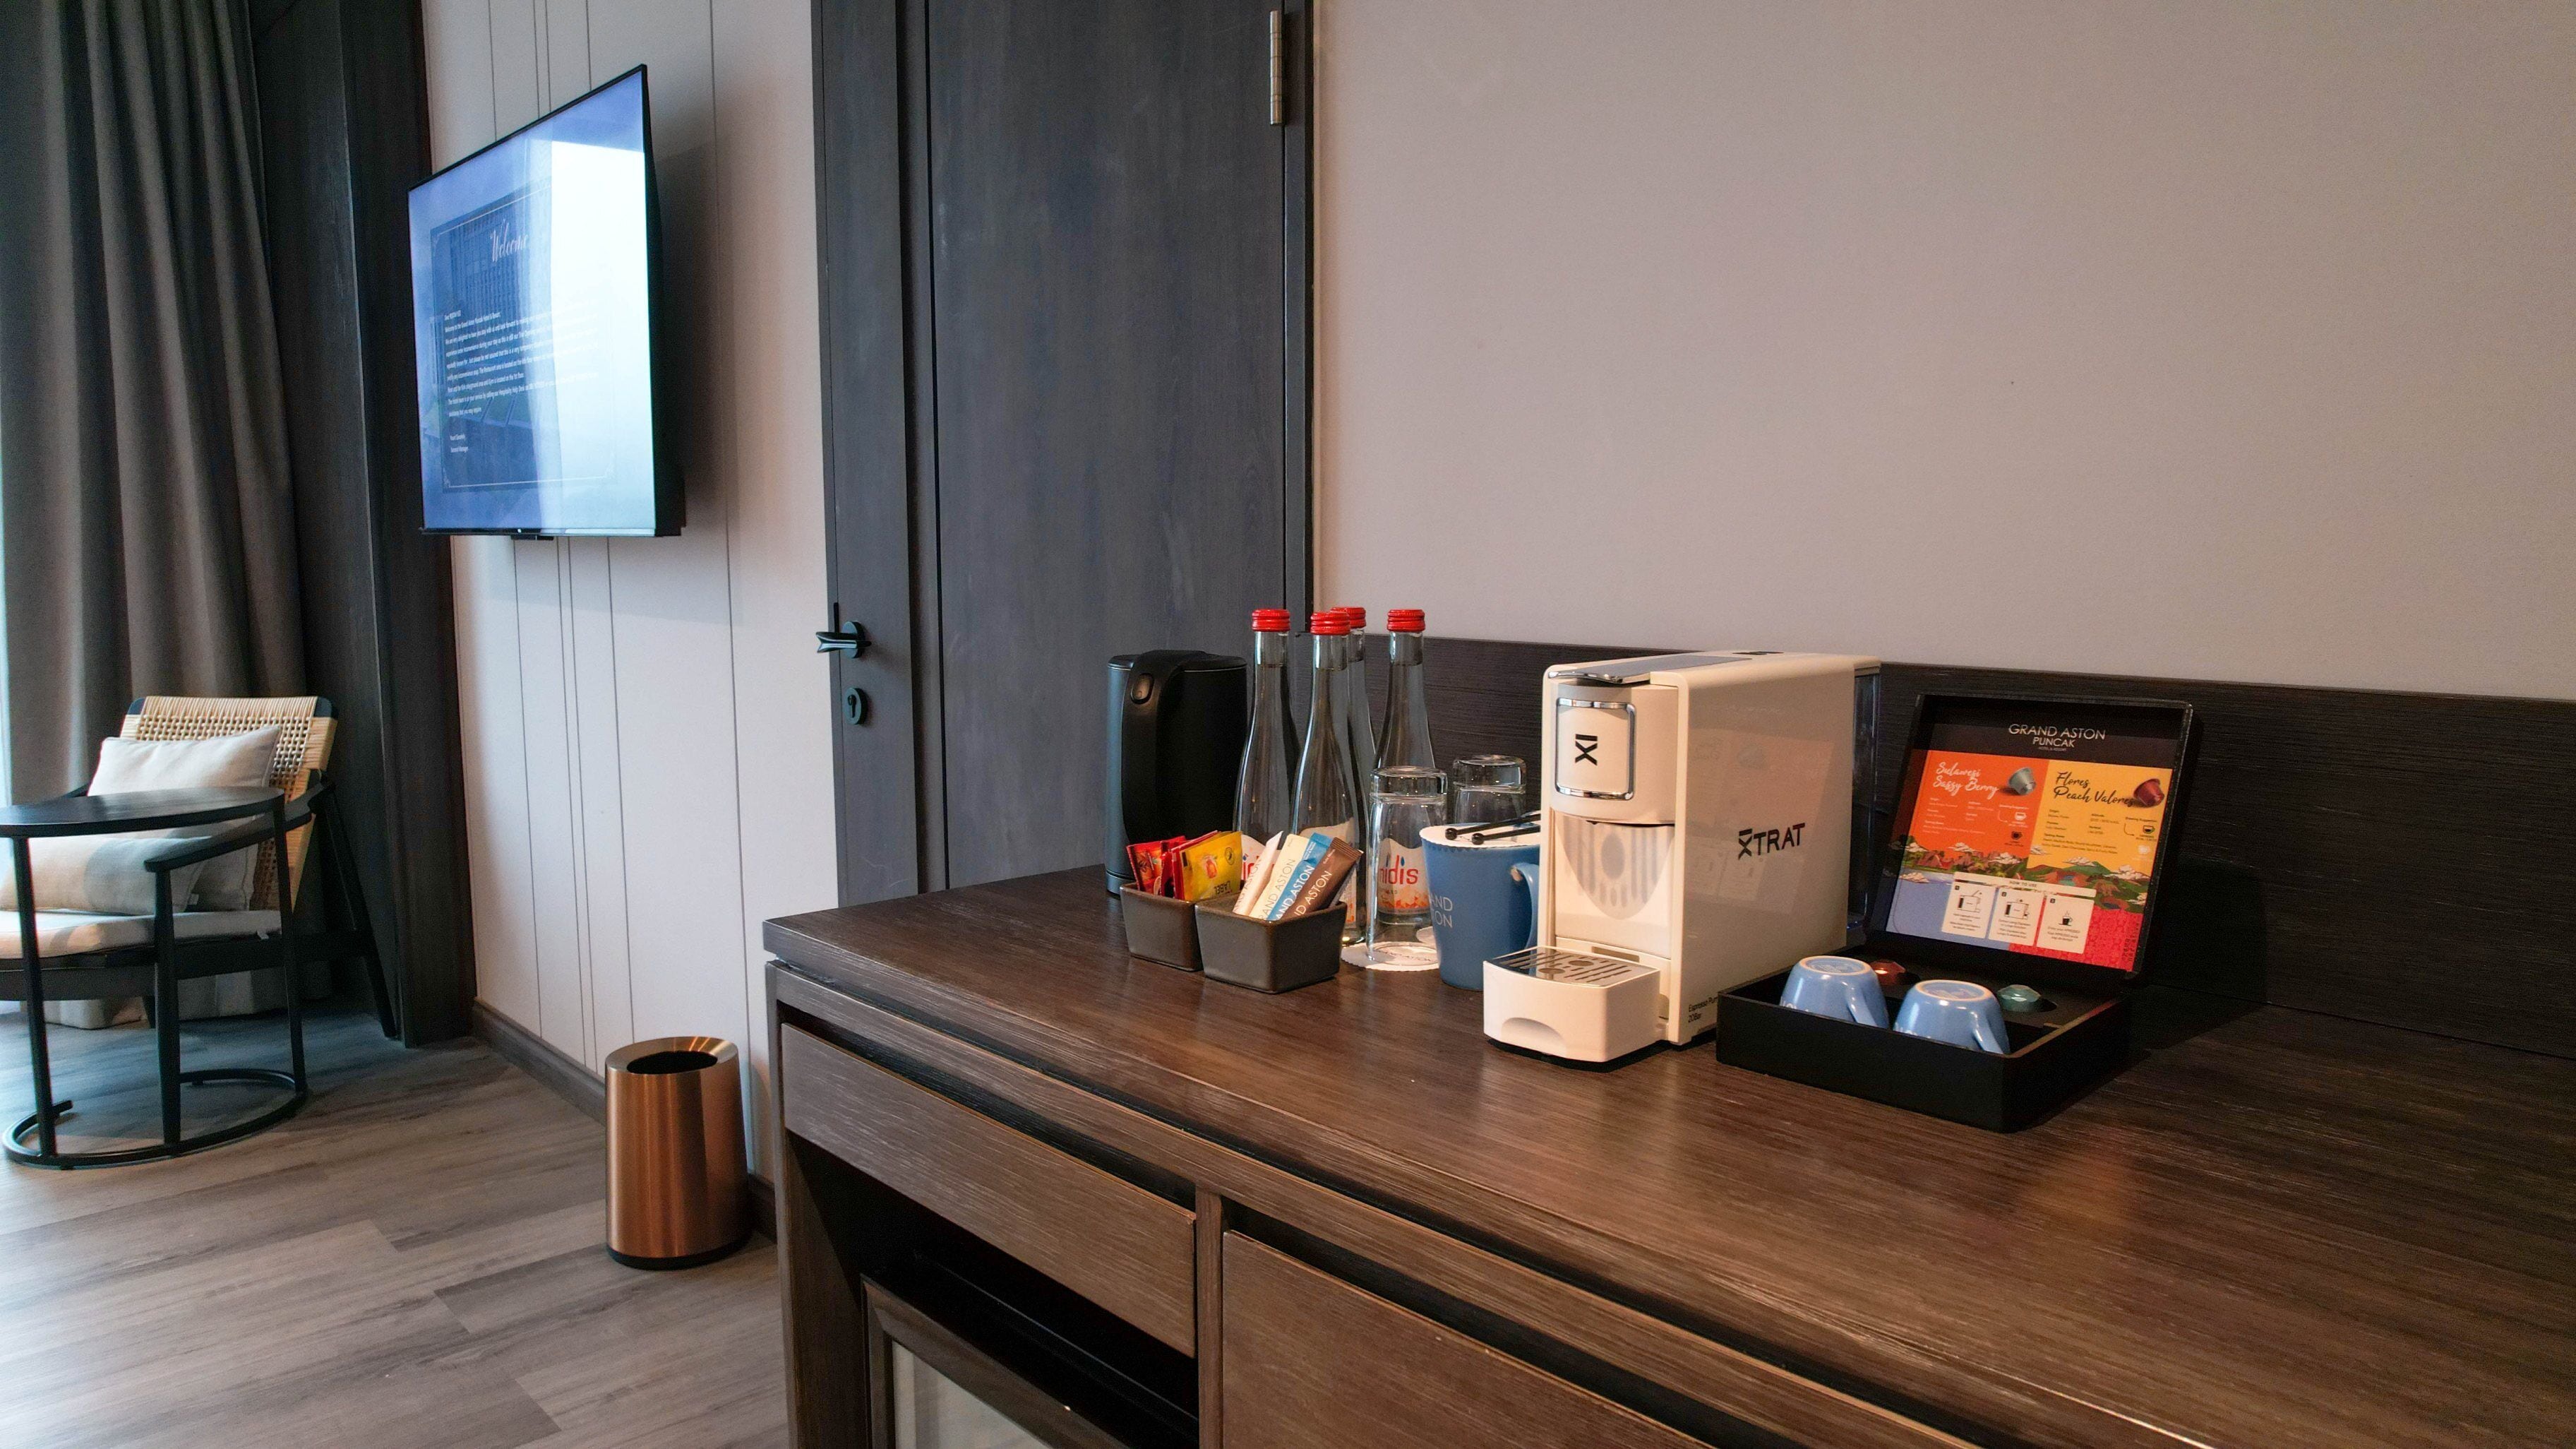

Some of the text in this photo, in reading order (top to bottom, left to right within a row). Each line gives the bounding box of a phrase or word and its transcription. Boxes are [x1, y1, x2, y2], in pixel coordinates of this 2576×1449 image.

[490, 218, 529, 262] Welcome
[2008, 724, 2106, 740] GRAND ASTON
[2032, 737, 2076, 748] PUNCAK
[1936, 762, 1981, 777] Sulawesi
[2055, 771, 2090, 789] Flores
[1933, 775, 1999, 799] Sassy Berry
[2054, 786, 2091, 803] Peach
[1276, 859, 1296, 893] ASTON
[1292, 865, 1315, 897] ASTON
[1305, 871, 1333, 905] ASTON
